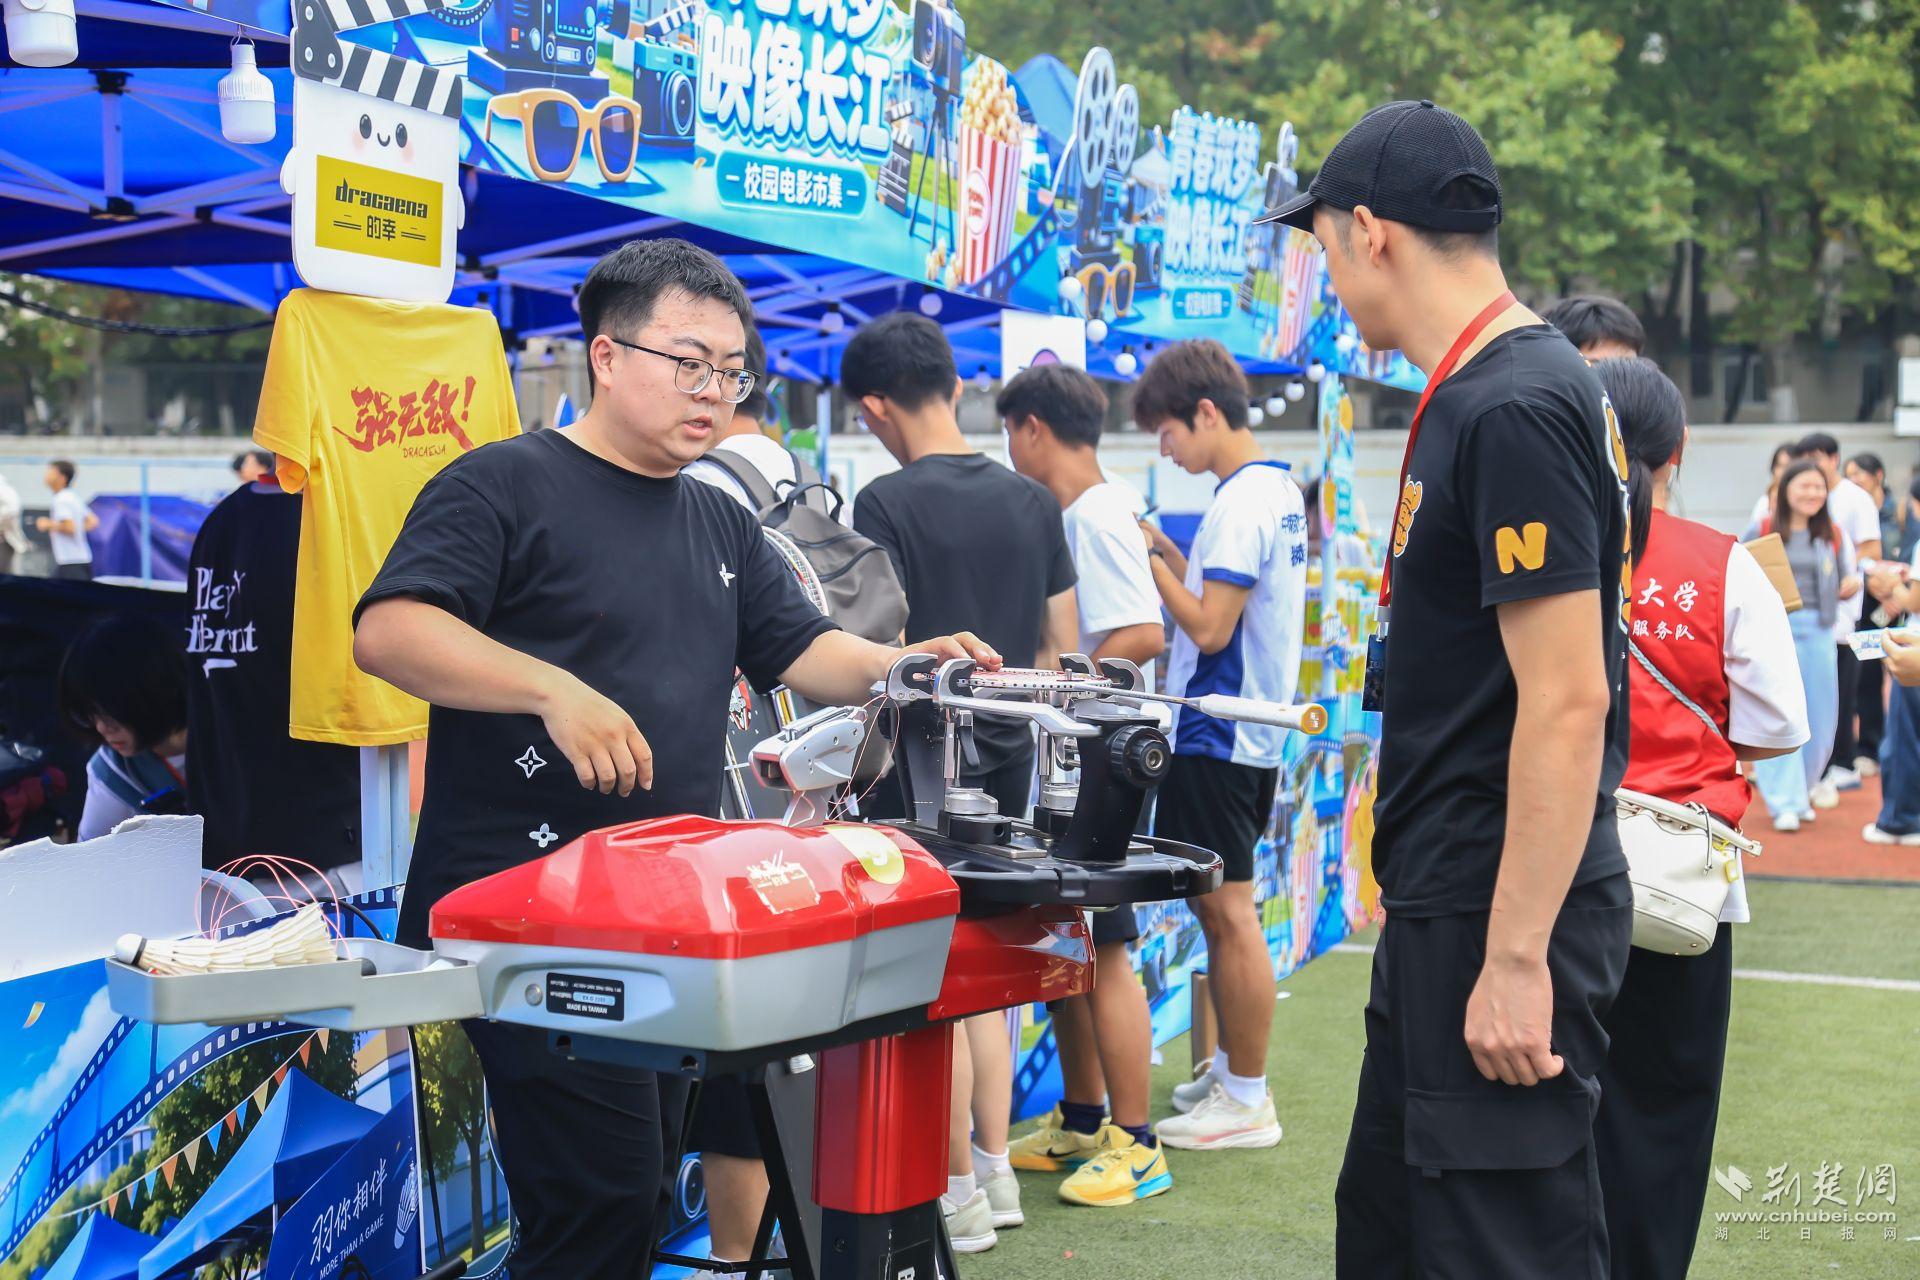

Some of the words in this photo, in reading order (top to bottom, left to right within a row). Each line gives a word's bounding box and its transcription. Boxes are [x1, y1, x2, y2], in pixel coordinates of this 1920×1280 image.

[700, 9, 891, 152] 映像长江
[335, 177, 428, 219] dracaena
[743, 161, 843, 208] 校园电影市集
[366, 214, 396, 241] 的幸
[402, 444, 447, 459] DRACAENA
[1495, 521, 1548, 575] N
[1637, 577, 1699, 612] 大学
[1631, 618, 1695, 641] 服务队
[566, 1003, 581, 1011] MADE
[588, 1005, 608, 1014] TAIWAN
[310, 1158, 388, 1266] 羽你相伴
[320, 1255, 339, 1280] MORE
[340, 1237, 358, 1261] THAN
[358, 1233, 364, 1245] A
[365, 1213, 384, 1239] GAME
